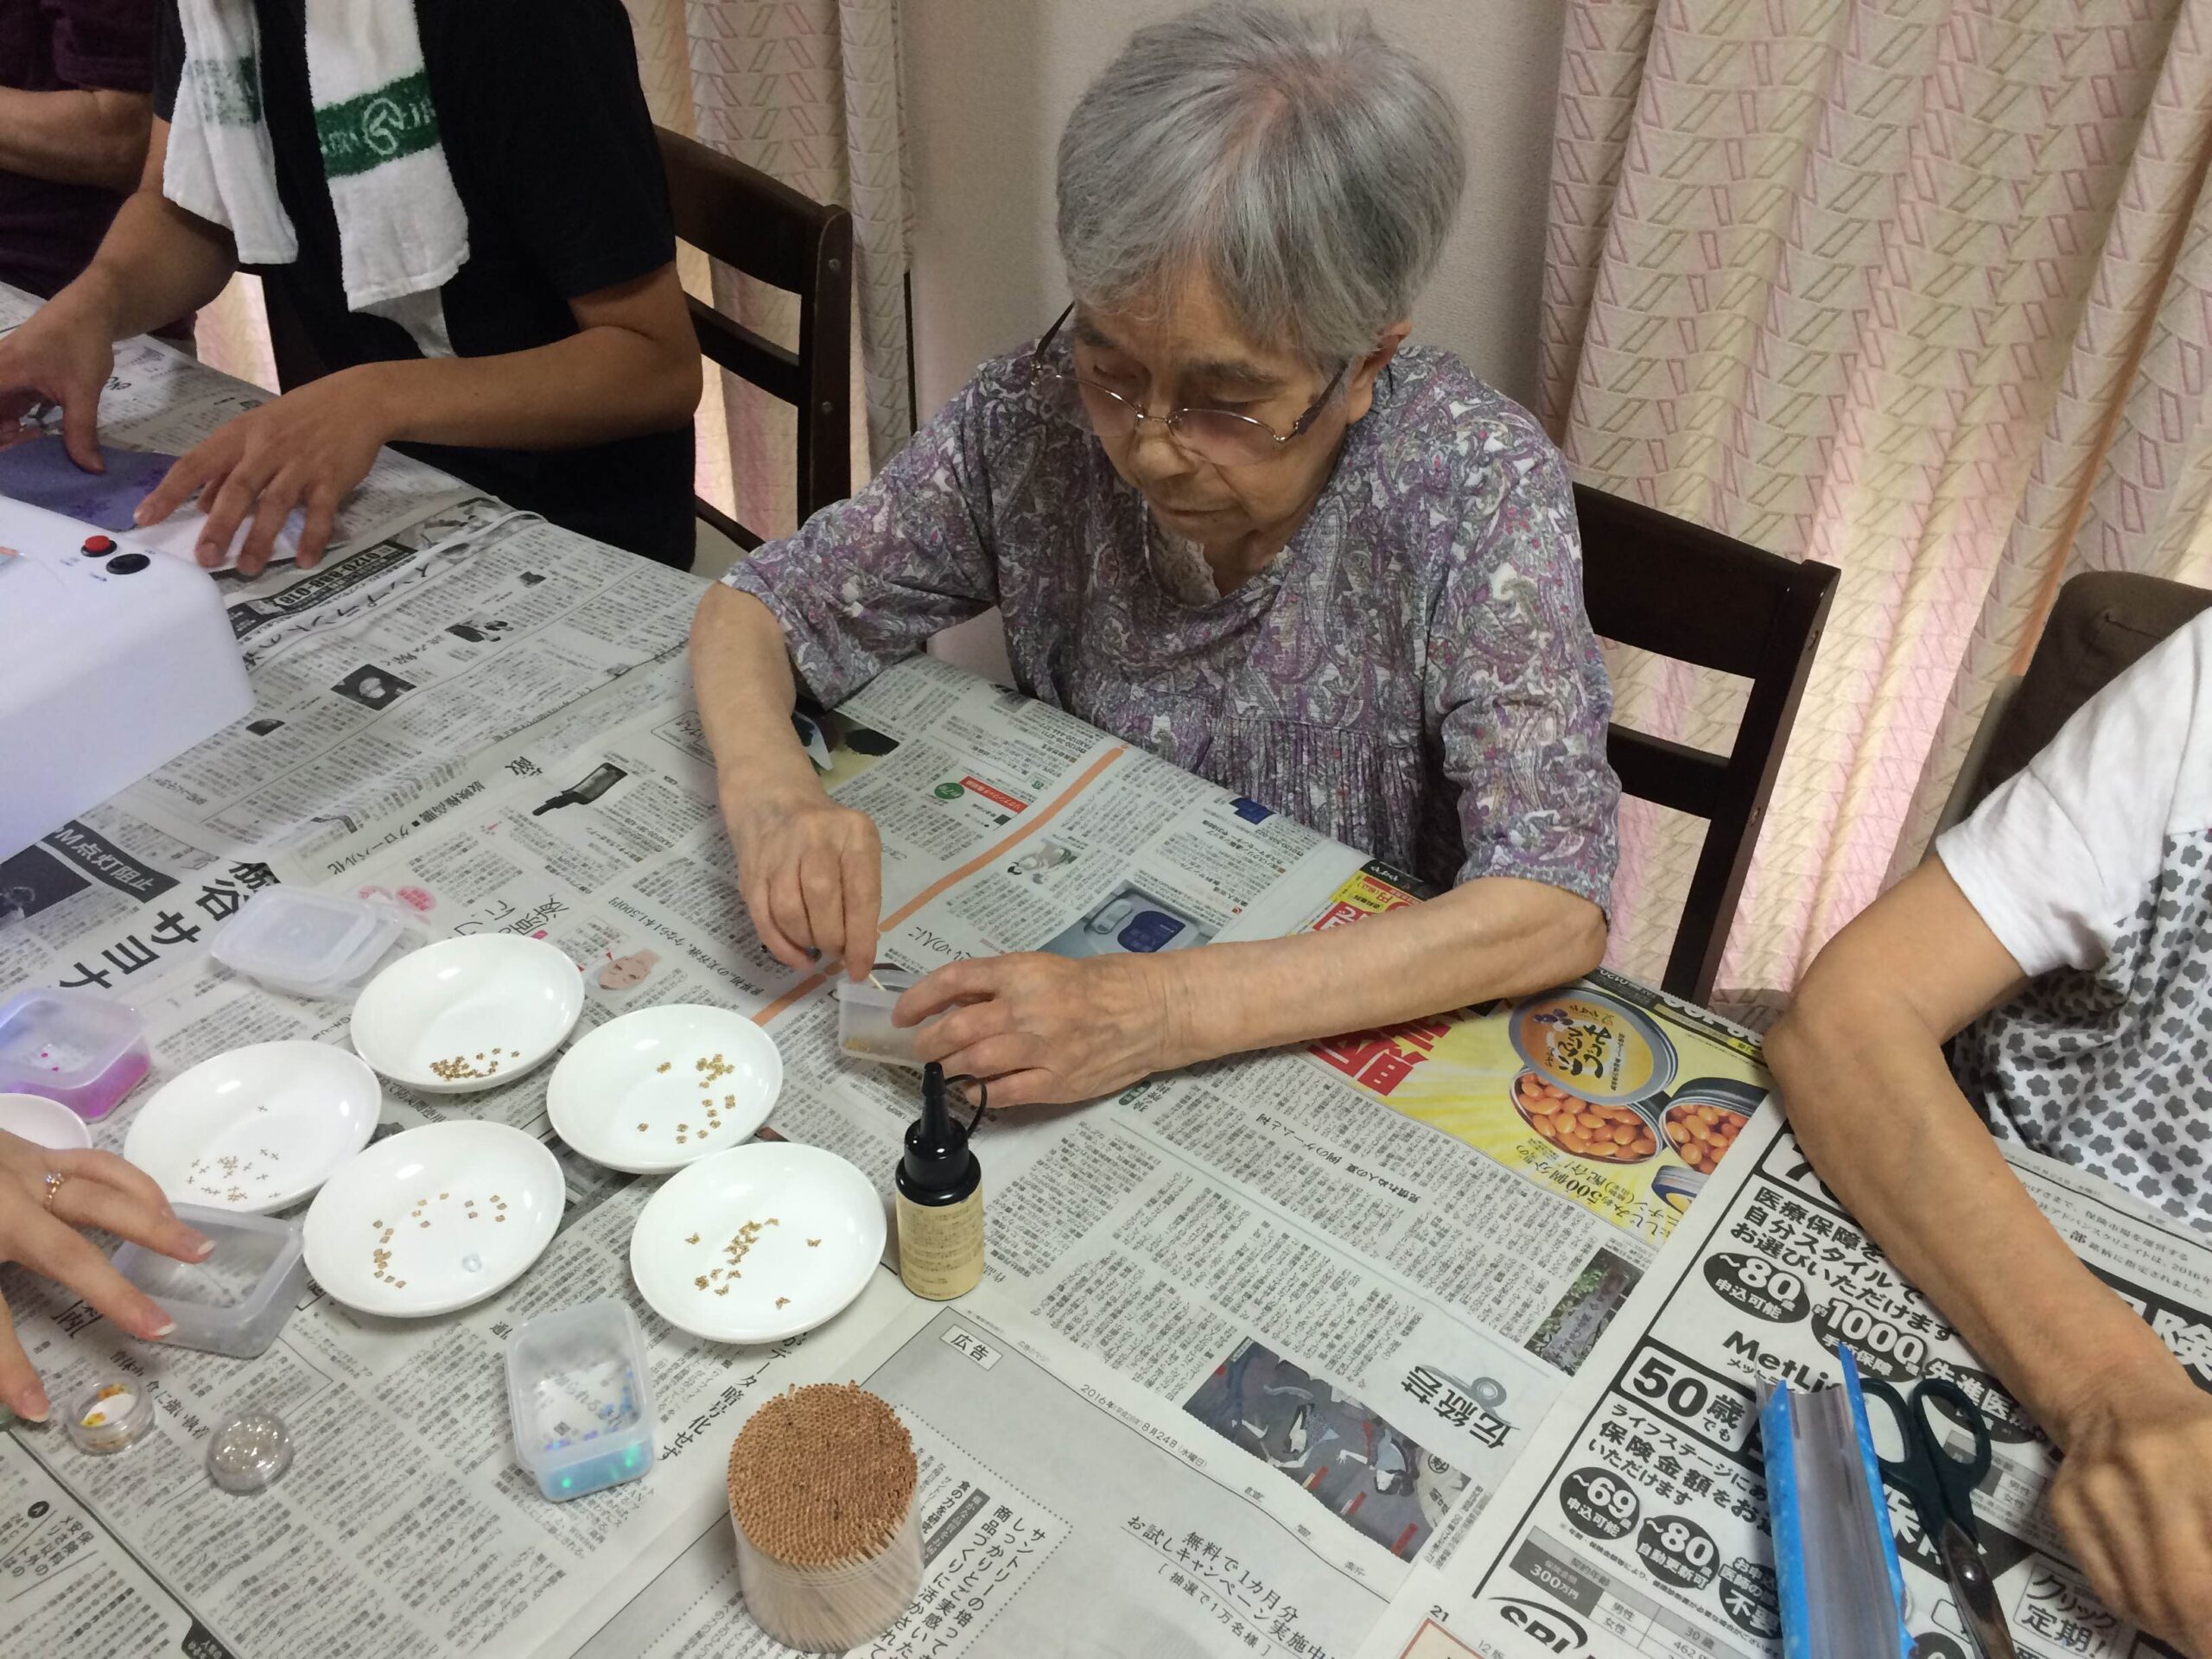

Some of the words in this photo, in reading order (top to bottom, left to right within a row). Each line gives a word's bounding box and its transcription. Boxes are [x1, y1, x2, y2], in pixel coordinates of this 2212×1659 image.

[416, 779, 487, 826] 放映権高騰
[54, 823, 156, 893] M点灯阻止
[326, 823, 411, 878] グローバル化
[1376, 890, 1392, 905] 円
[1345, 1160, 1422, 1208] 見慣れぬ人の夏
[1754, 1185, 1885, 1264] 医療保障を
[1744, 1205, 1923, 1305] 自分スタイルで
[1714, 1277, 1783, 1321] 申込可能
[1730, 1221, 1957, 1342] お選びいただけます
[949, 1332, 989, 1363] 広告
[1400, 1364, 1520, 1449] 伝統芸
[1702, 1416, 1732, 1443] でも
[1587, 1438, 1694, 1506] いただけます
[921, 1479, 972, 1535] 食の力を研究
[1567, 1497, 1621, 1538] 申込可能
[889, 1517, 1026, 1659] しっかりとご実感いた
[1529, 1564, 1580, 1601] 300万円
[1570, 1556, 1611, 1588] 契約年齢
[1637, 1541, 1710, 1590] 自動更新可
[1429, 1605, 1450, 1624] 21
[1611, 1600, 1636, 1623] 男性
[2027, 1574, 2116, 1628] クリック
[1603, 1616, 1627, 1637] 女性
